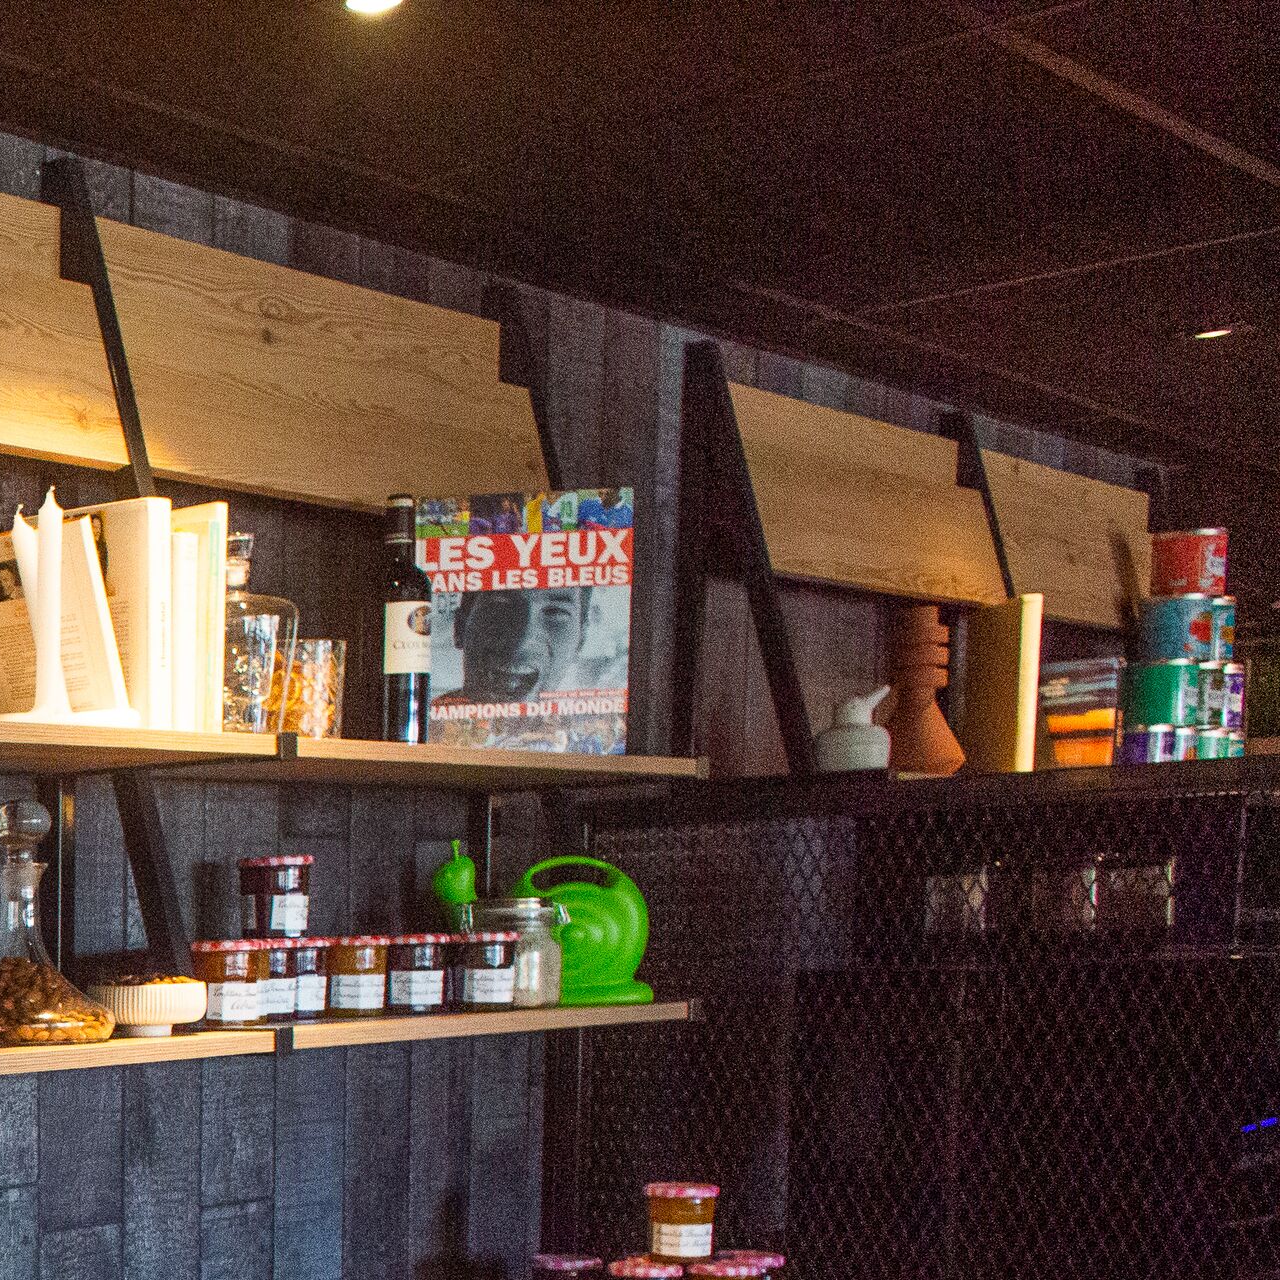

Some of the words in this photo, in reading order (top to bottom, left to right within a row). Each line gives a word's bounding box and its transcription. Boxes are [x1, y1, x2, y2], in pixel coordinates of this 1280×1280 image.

[415, 535, 496, 571] LES
[510, 530, 630, 568] YEUX
[431, 570, 484, 592] ANS
[491, 569, 539, 589] LES
[547, 565, 630, 588] BLEUS
[526, 700, 552, 717] DU
[558, 698, 626, 715] MONDE
